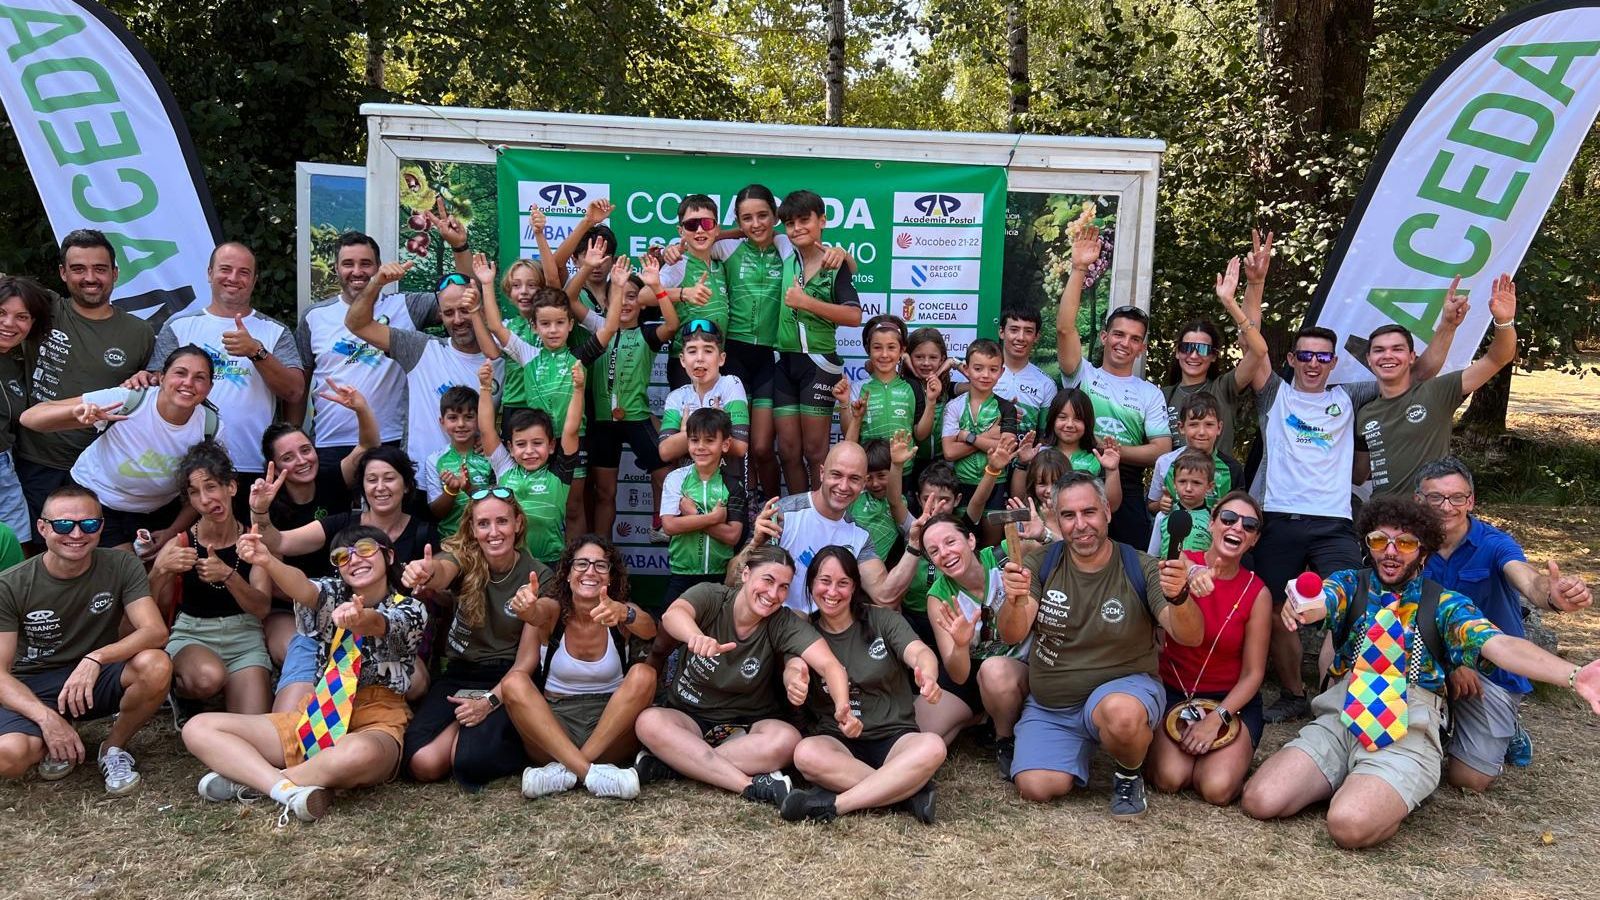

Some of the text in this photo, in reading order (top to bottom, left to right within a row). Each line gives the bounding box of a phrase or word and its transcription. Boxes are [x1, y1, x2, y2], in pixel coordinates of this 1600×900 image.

[528, 206, 573, 214] Aademia
[1344, 41, 1600, 376] ACEDA
[903, 215, 976, 224] Academia Postal
[914, 236, 979, 247] Xacobeo 21-22
[851, 273, 874, 283] ntos
[918, 302, 968, 310] CONCELLO
[918, 313, 957, 321] MACEDA
[624, 555, 670, 568] ABAN
[1041, 605, 1069, 618] ABANCA
